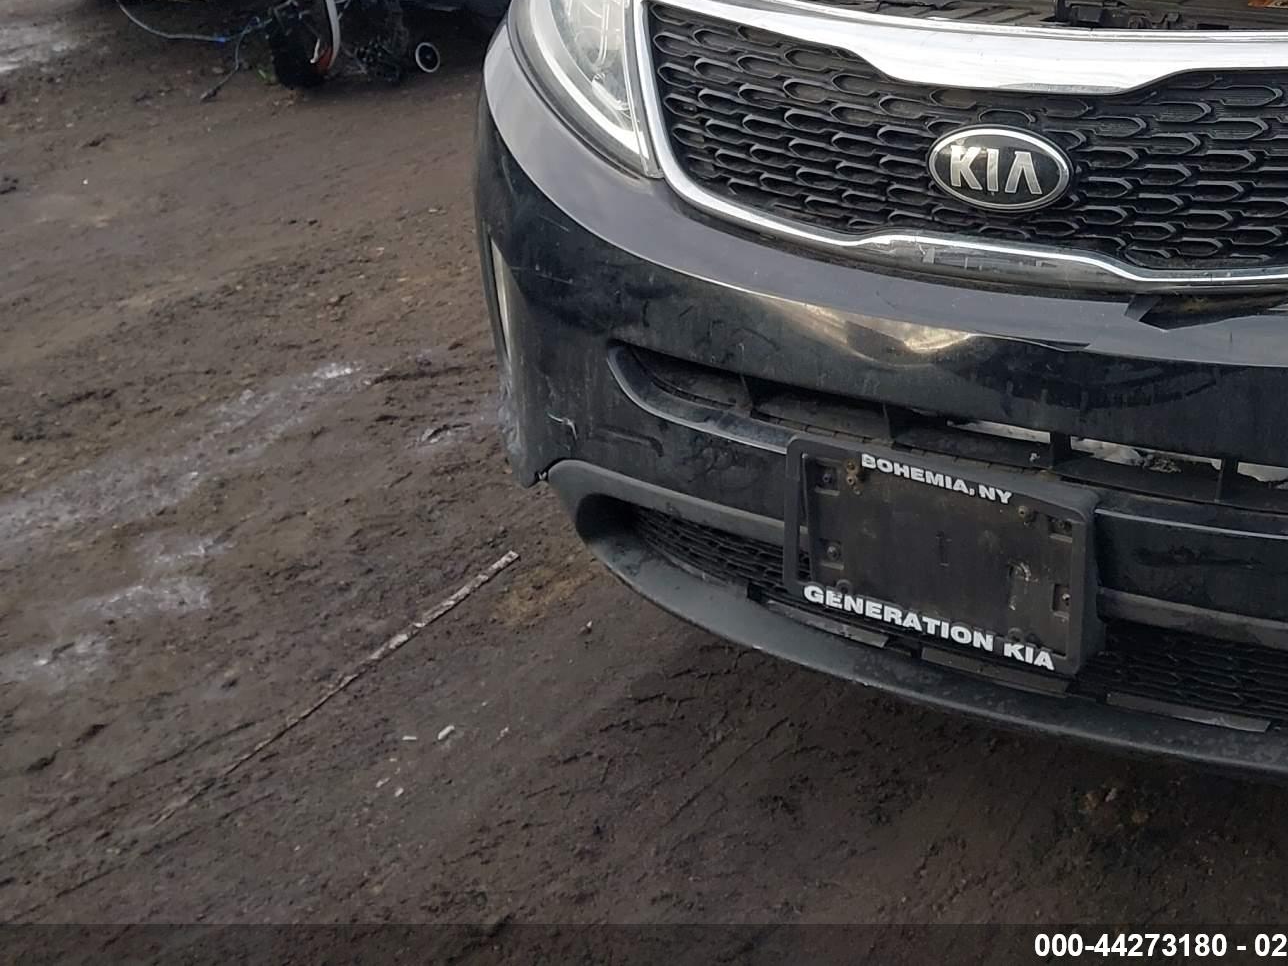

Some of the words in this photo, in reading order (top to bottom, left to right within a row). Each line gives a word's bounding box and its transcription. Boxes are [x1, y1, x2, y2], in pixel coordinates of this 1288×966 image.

[949, 144, 1043, 195] KIA
[861, 453, 975, 496] BOHEMIA,
[978, 484, 1013, 505] NY
[803, 585, 994, 652] GENERATION
[1003, 641, 1055, 671] KIA
